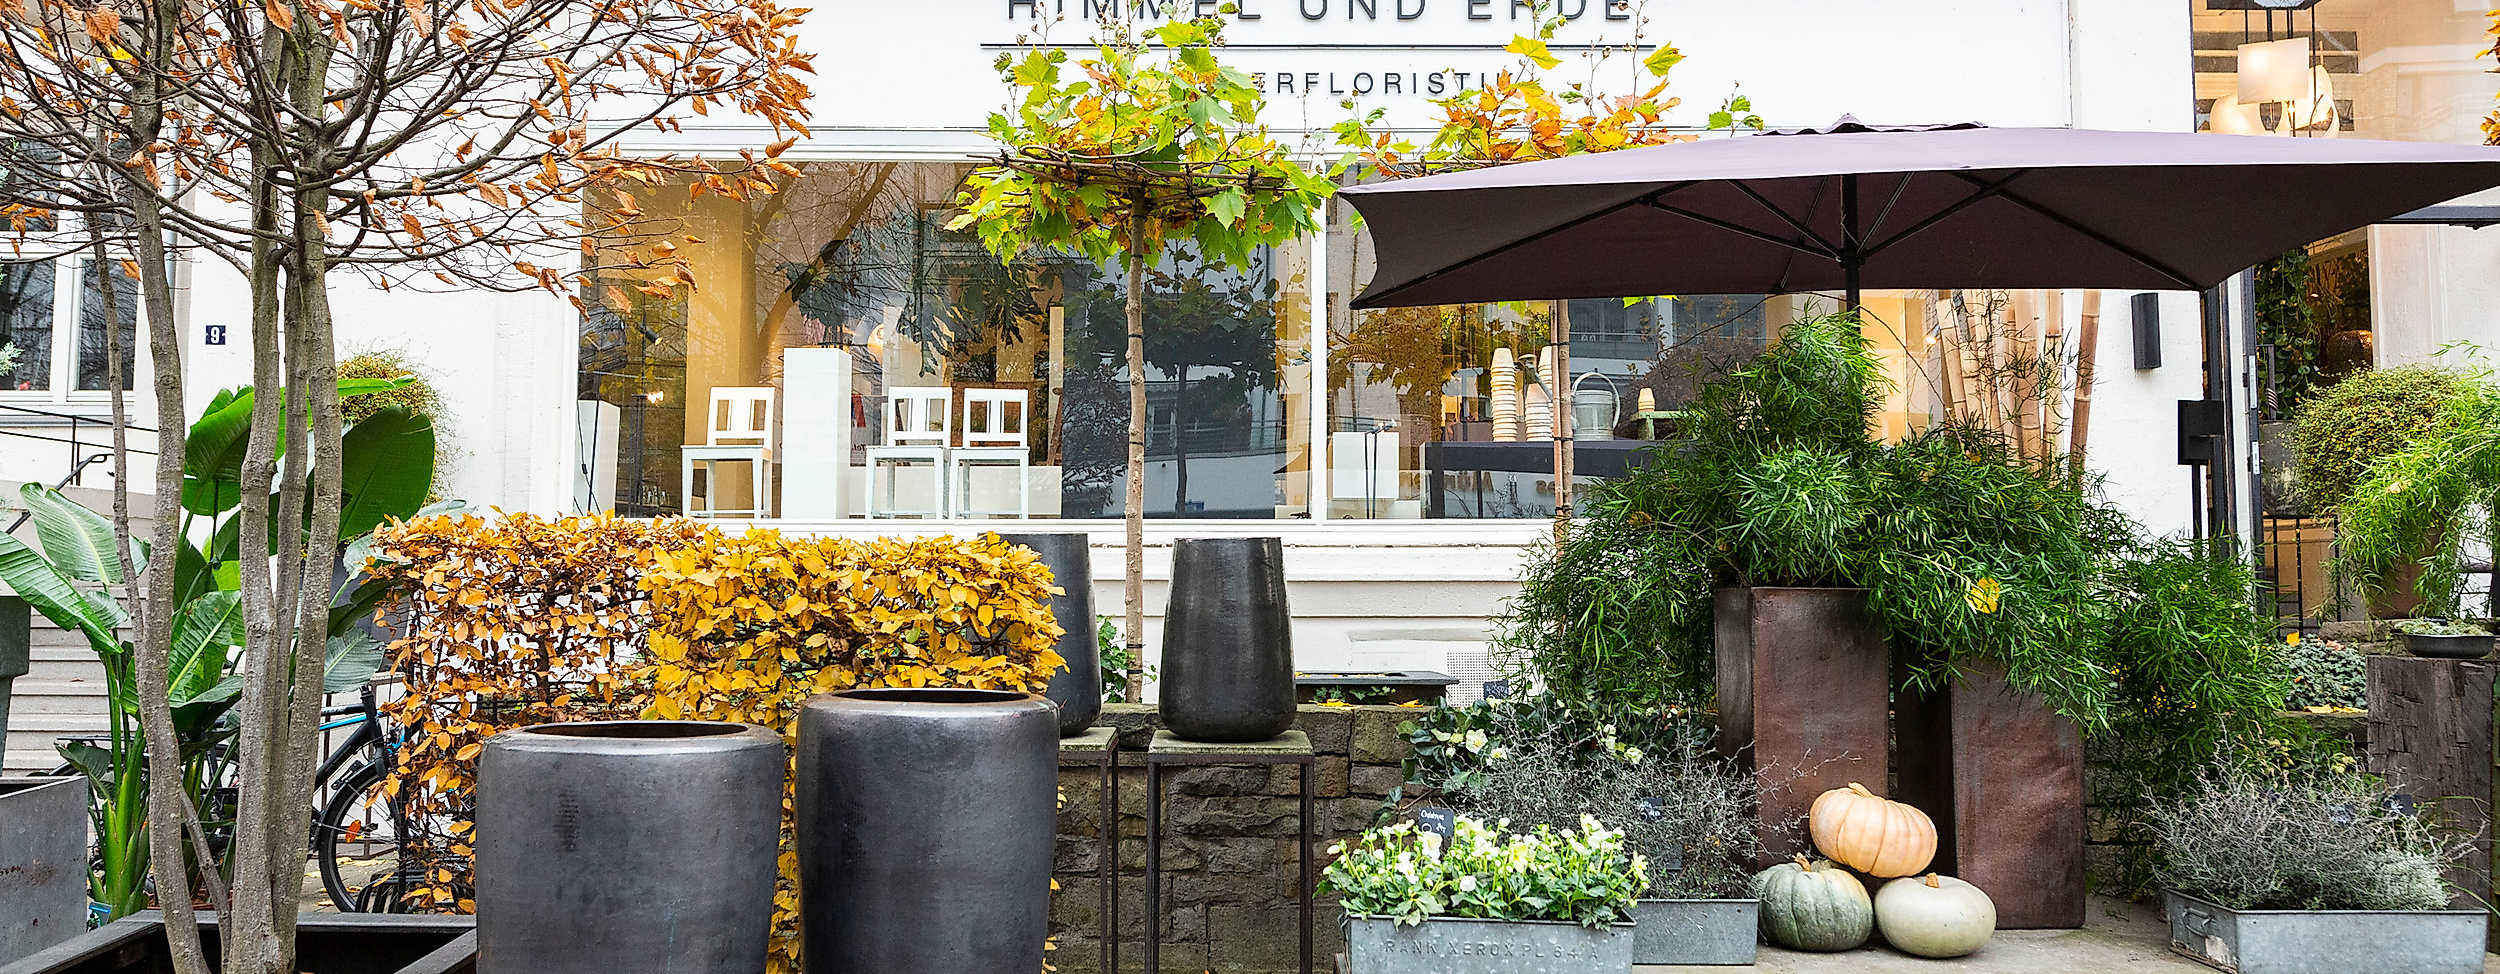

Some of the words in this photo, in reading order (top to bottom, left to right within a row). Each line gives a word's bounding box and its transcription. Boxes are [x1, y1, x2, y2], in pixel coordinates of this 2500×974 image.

[1467, 0, 1630, 20] EDE
[1199, 72, 1513, 95] ERFLORISTI
[210, 326, 220, 344] 9
[1385, 939, 1437, 955] RANK
[1448, 940, 1514, 957] XEROX
